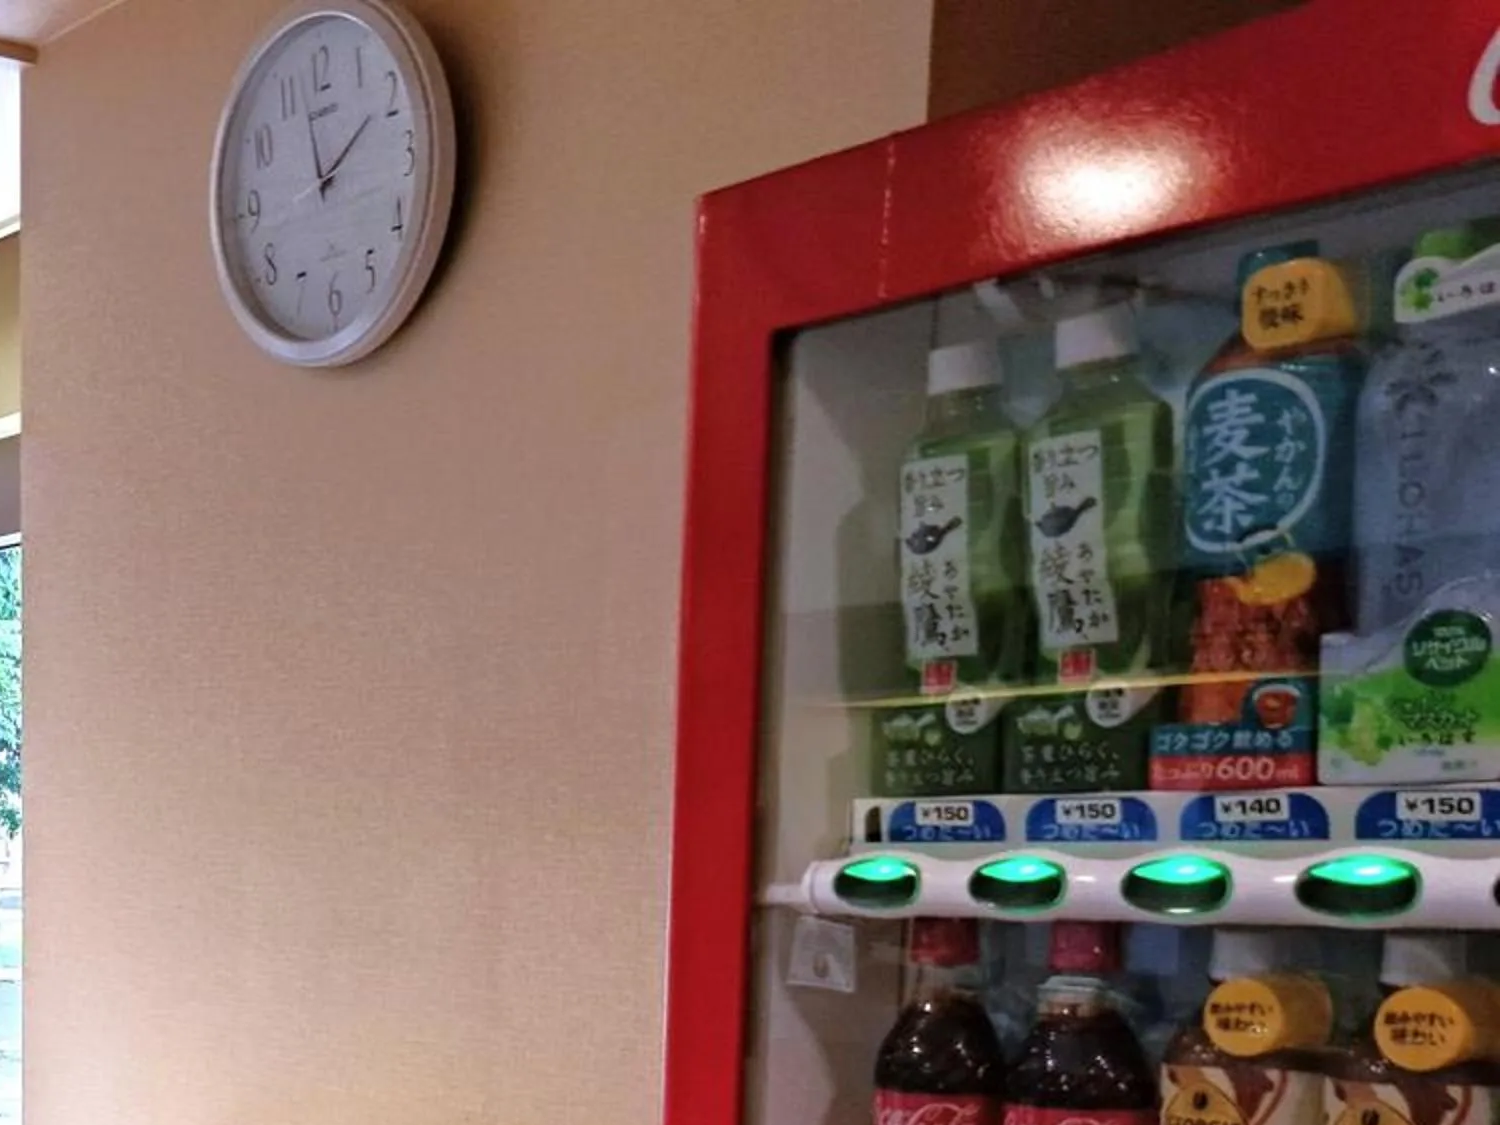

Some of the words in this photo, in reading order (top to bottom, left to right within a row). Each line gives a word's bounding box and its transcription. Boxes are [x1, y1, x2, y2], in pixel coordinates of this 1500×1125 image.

[311, 45, 332, 94] 12
[280, 77, 296, 121] 11
[386, 70, 399, 118] 2
[256, 124, 273, 169] 10
[404, 130, 415, 177] 3
[247, 189, 261, 234] 9
[264, 243, 278, 286] 8
[365, 248, 376, 294] 5
[329, 271, 342, 316] 6
[1197, 388, 1271, 535] 麦茶
[1040, 542, 1092, 641] 綾鷹
[920, 804, 970, 822] ¥150
[1061, 801, 1118, 819] ¥150
[1220, 797, 1282, 815] ¥140
[1404, 796, 1475, 816] ¥150
